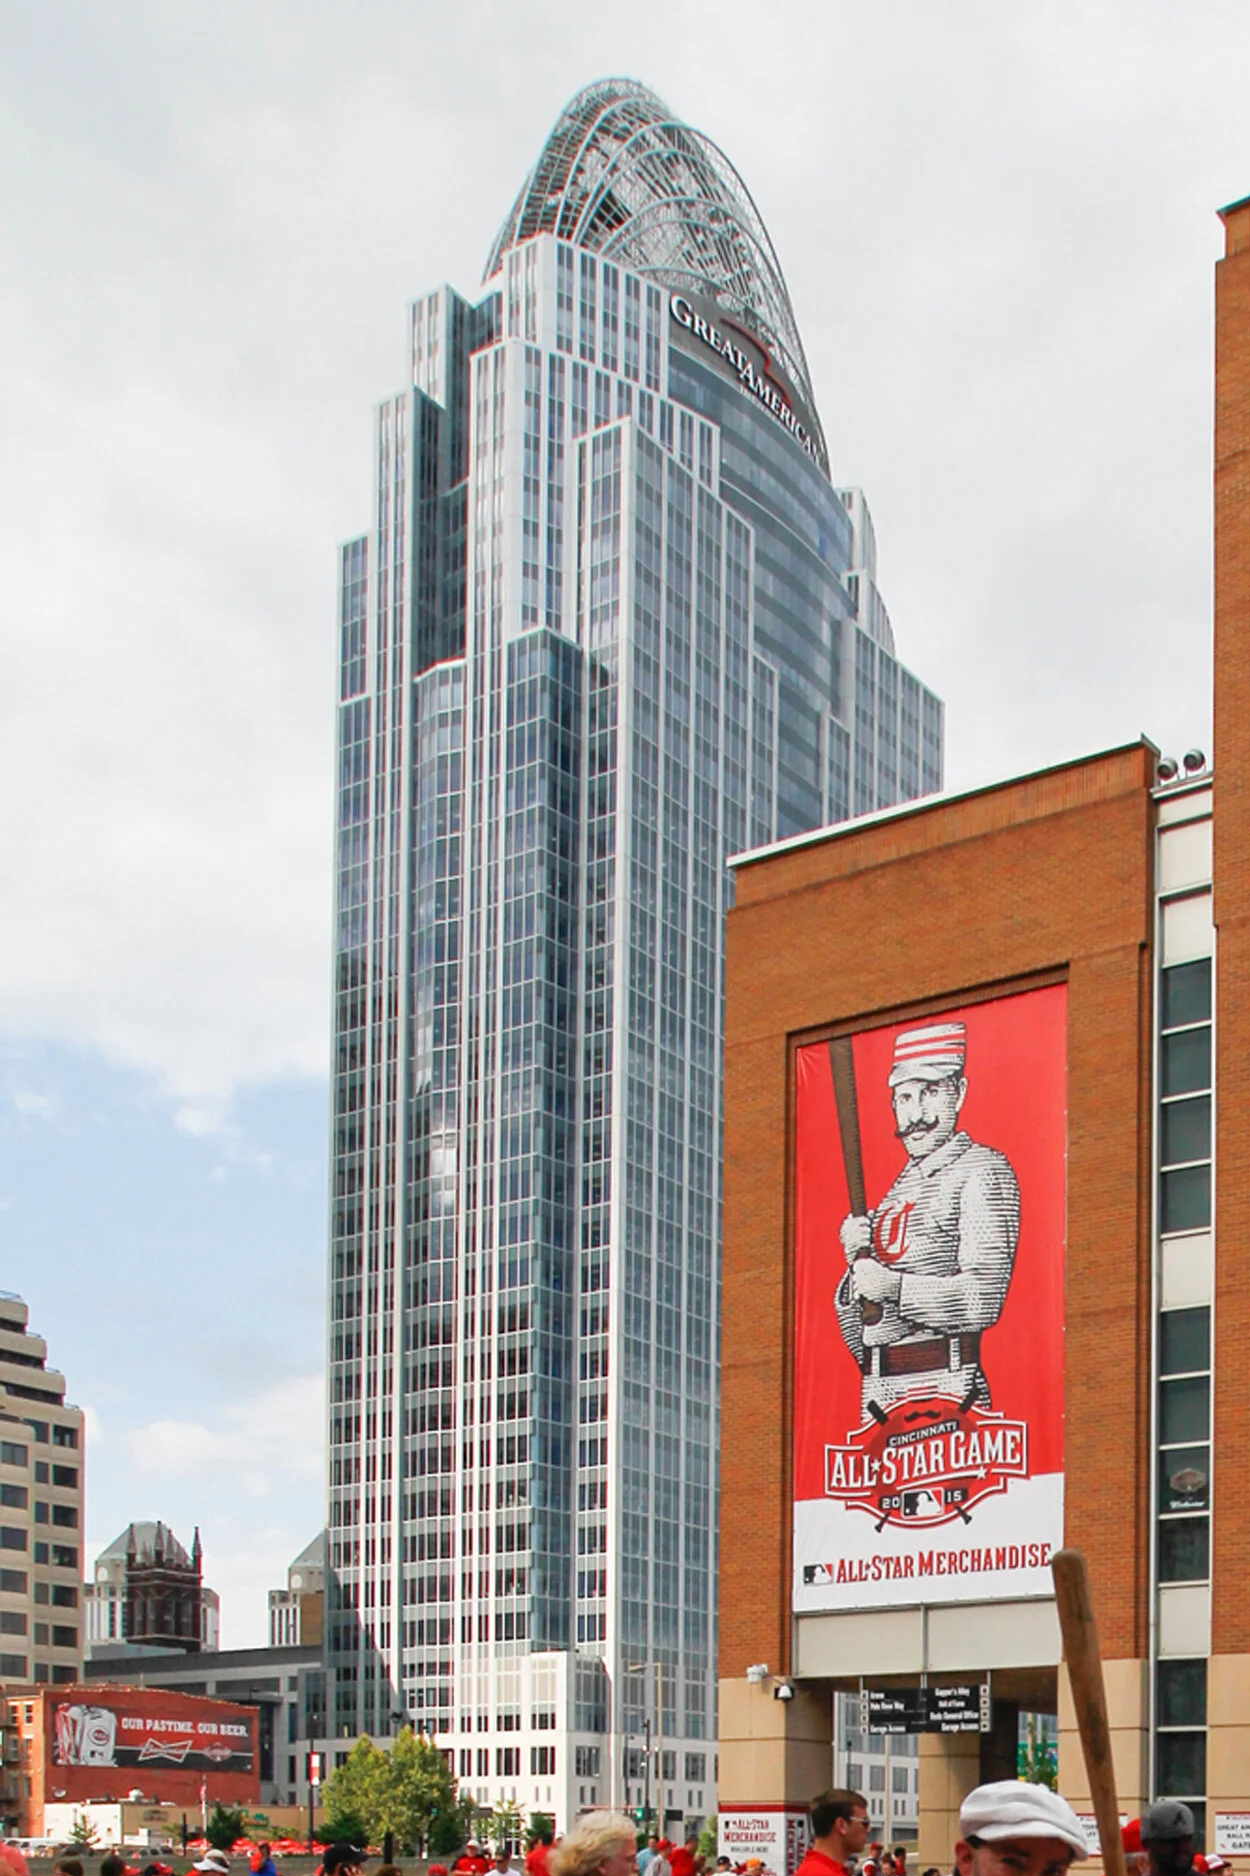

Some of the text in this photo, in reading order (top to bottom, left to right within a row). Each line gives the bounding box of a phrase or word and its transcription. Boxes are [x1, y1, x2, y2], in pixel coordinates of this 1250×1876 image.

[670, 294, 750, 371] GREAT
[888, 1420, 958, 1448] CINCINNATI
[949, 1429, 1022, 1470] GAME
[881, 1490, 962, 1510] 20 15
[918, 1542, 1051, 1577] MERCHANDISE
[121, 1717, 144, 1730] OUR
[146, 1719, 195, 1734] PASTIME.
[197, 1723, 217, 1735] OUR
